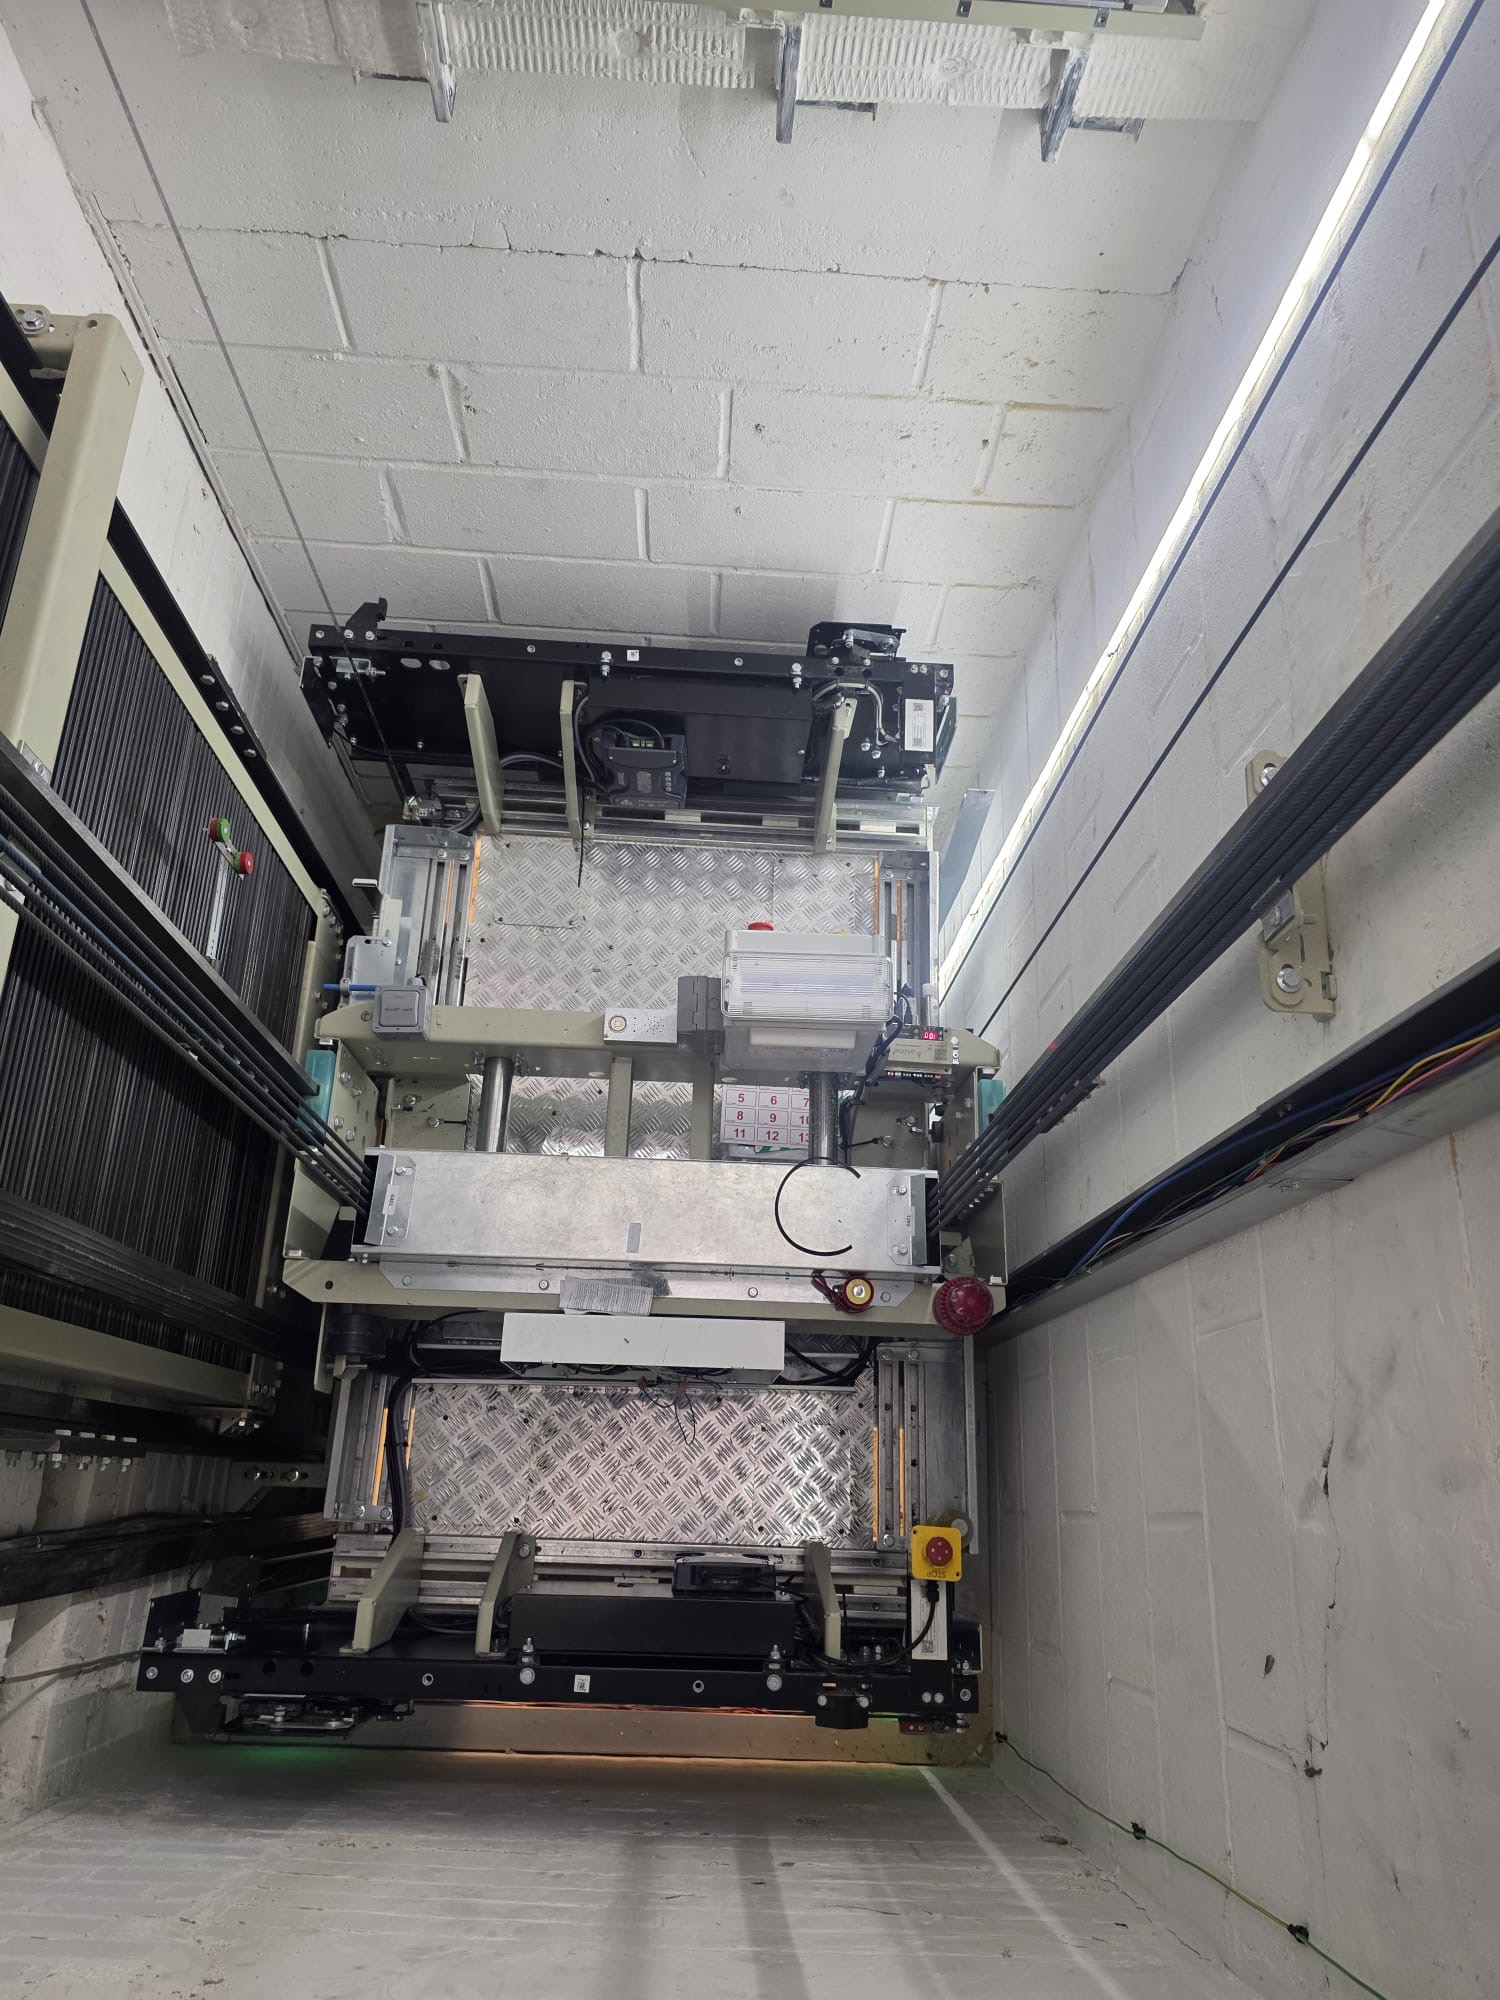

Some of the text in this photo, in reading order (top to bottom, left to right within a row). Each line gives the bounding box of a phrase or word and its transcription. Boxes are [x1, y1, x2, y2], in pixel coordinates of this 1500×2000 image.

[738, 1093, 745, 1103] 5
[770, 1095, 778, 1106] 6
[803, 1097, 809, 1107] 7
[736, 1110, 744, 1121] 8
[769, 1113, 777, 1123] 9
[733, 1128, 746, 1138] 11
[765, 1130, 779, 1141] 12
[926, 1569, 946, 1579] STOP
